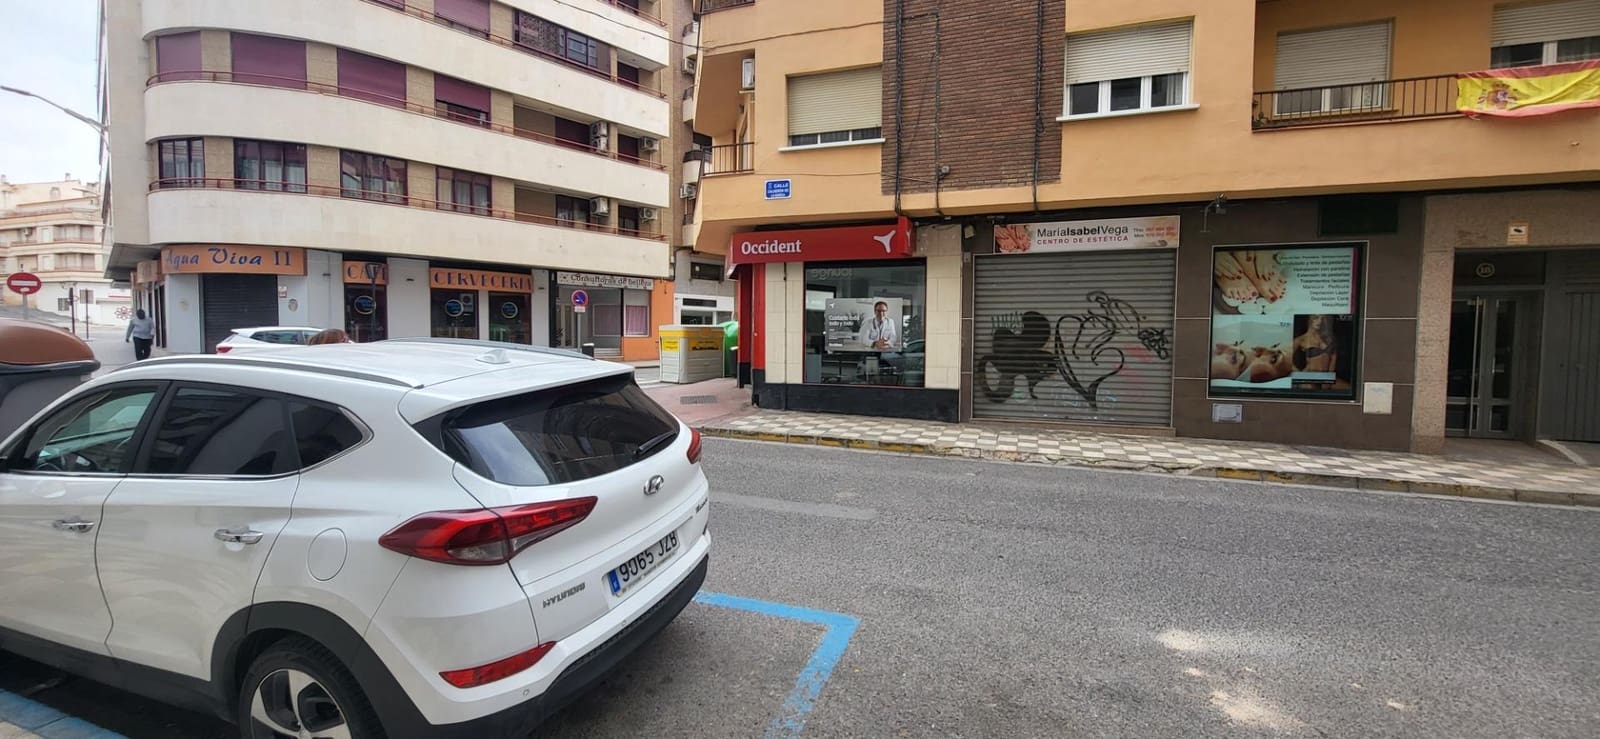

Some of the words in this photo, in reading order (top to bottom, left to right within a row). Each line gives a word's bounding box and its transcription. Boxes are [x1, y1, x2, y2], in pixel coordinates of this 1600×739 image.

[741, 239, 802, 255] Occident
[165, 248, 200, 270] Agua
[620, 552, 654, 582] 9065
